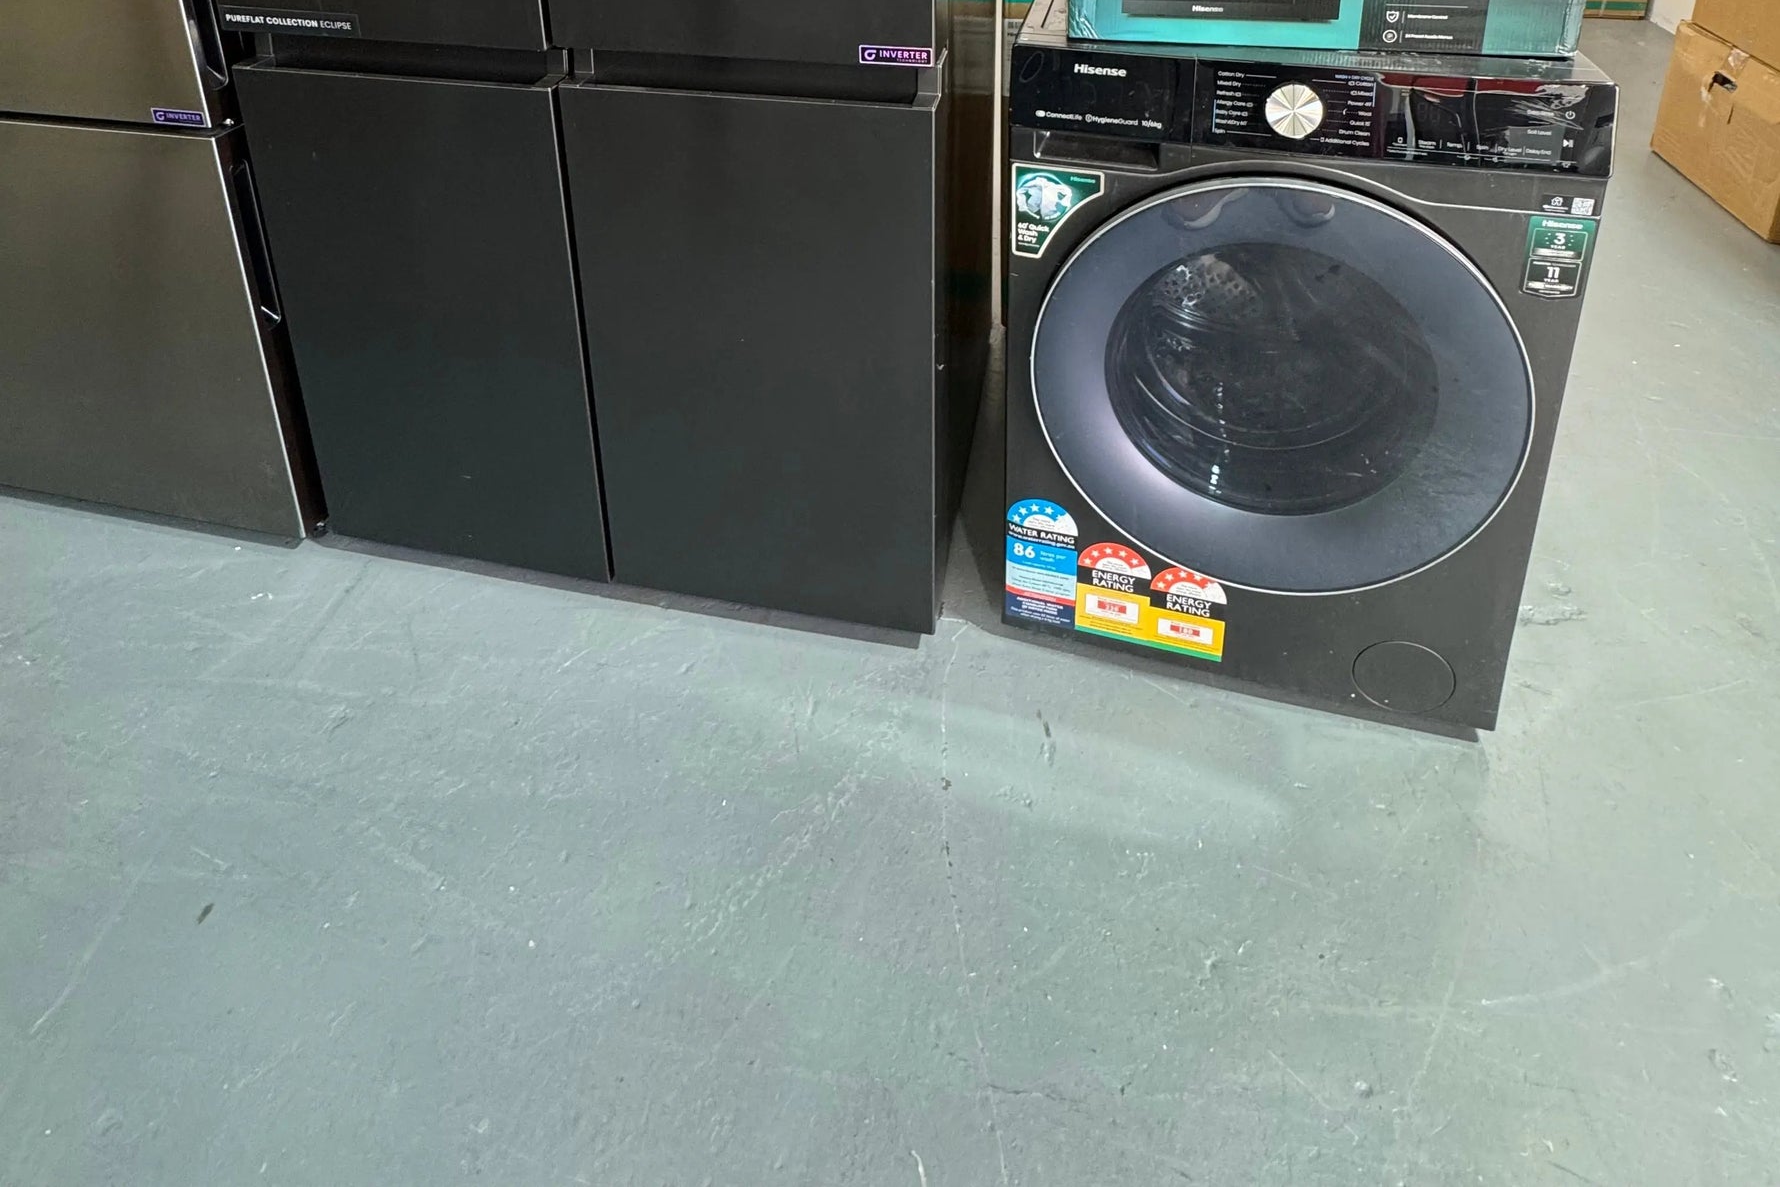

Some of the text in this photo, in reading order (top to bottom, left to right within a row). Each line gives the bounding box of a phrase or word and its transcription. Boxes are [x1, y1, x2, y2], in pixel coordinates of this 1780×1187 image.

[1191, 5, 1224, 13] Hisense
[225, 13, 352, 31] PUREFLAT COLLECTION ECLIPSE
[879, 50, 928, 60] INVERTER
[1073, 63, 1127, 77] Hisense
[1235, 71, 1245, 79] Dry
[1232, 80, 1242, 88] Dry
[166, 112, 201, 121] INVERTER
[1046, 111, 1082, 121] ConnectLife
[1092, 115, 1138, 126] HygieneGuard
[1352, 139, 1370, 147] Cycles
[1028, 224, 1050, 233] Quick
[1541, 219, 1584, 230] Hisense
[1017, 228, 1038, 237] Wash
[1553, 232, 1566, 245] 3
[1023, 235, 1037, 244] Dry
[1546, 266, 1560, 279] 11
[1008, 522, 1039, 538] WATER
[1040, 531, 1075, 544] RATING
[1013, 542, 1036, 559] 86
[1091, 569, 1136, 585] ENERGY
[1092, 577, 1134, 593] RATING
[1166, 593, 1212, 610] ENERGY
[1166, 601, 1211, 618] RATING
